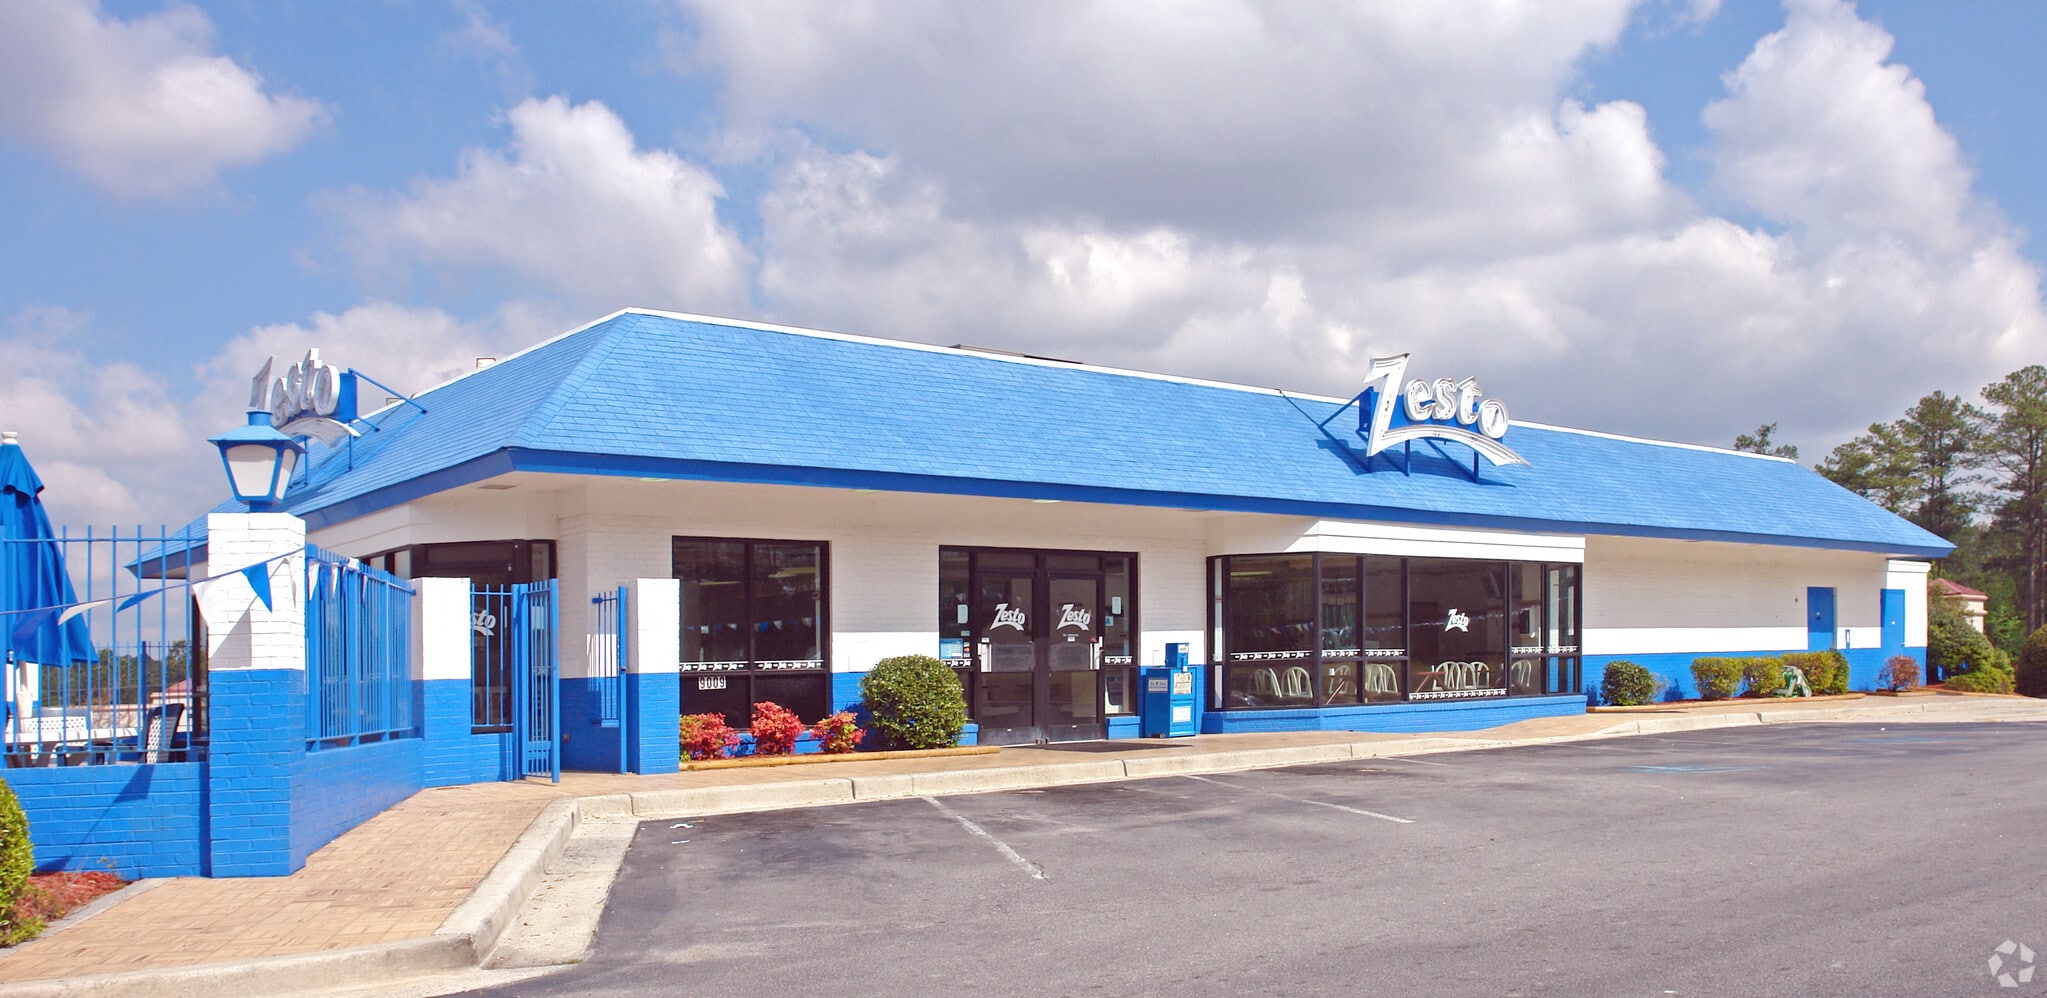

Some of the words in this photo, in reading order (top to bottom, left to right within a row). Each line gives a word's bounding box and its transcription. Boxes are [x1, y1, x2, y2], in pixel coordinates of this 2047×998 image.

[1362, 352, 1532, 467] Zesto
[990, 603, 1026, 631] Zesto
[1056, 603, 1091, 631] Zesto
[1444, 608, 1469, 633] Zesto
[700, 676, 725, 689] 9009
